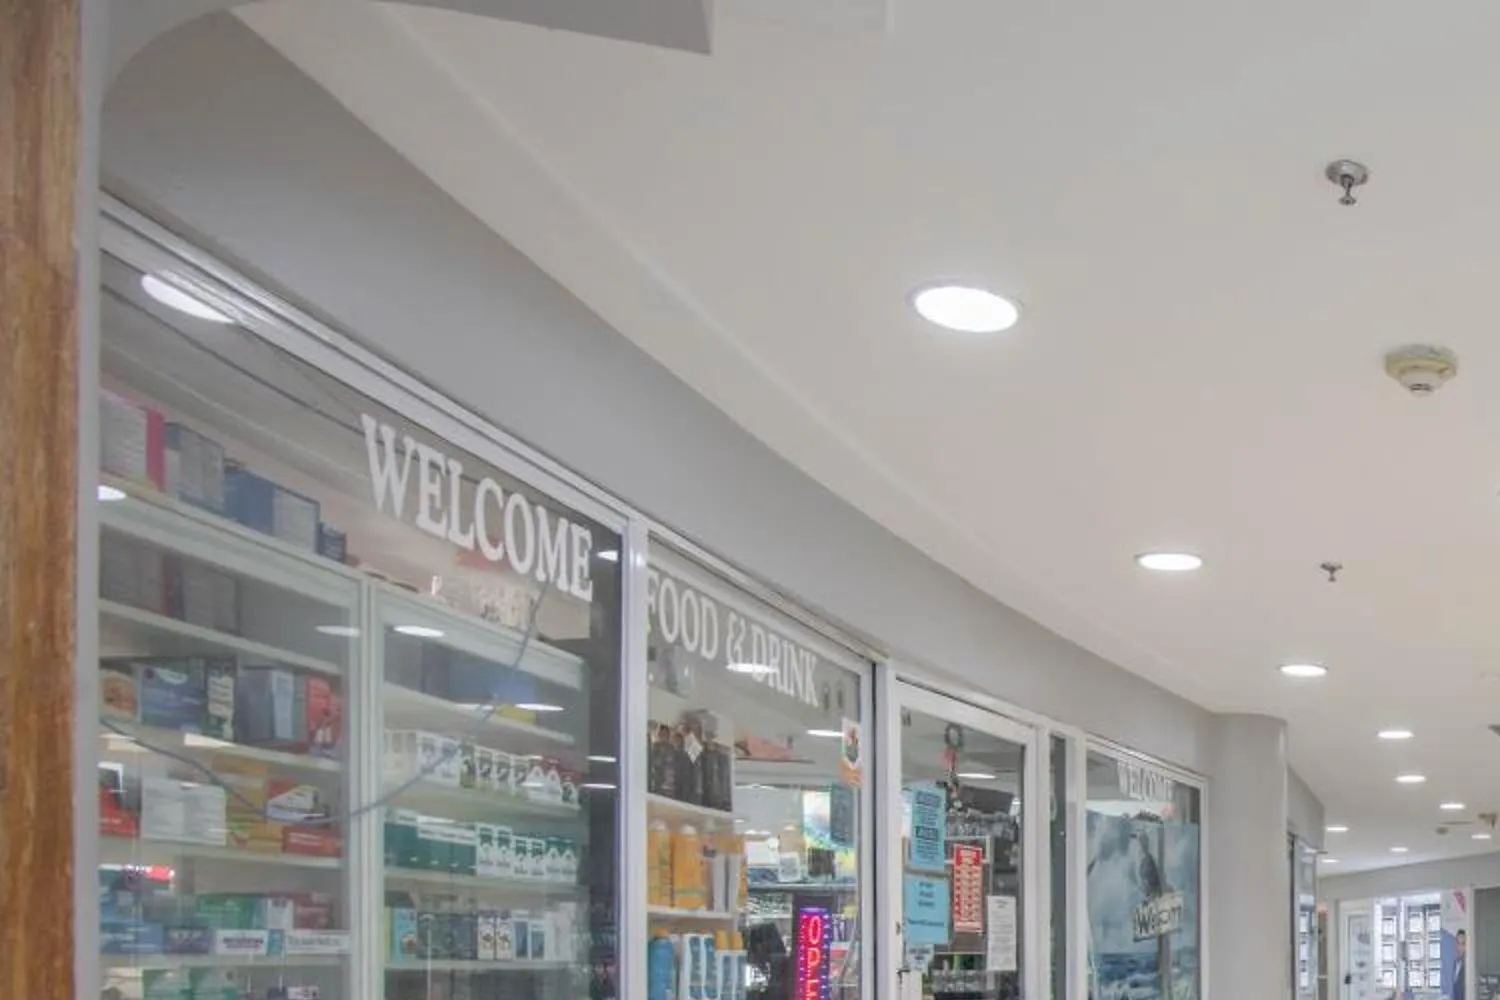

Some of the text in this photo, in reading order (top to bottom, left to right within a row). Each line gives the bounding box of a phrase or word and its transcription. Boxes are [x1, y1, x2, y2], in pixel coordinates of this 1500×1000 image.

[361, 413, 593, 602] WELCOME
[647, 569, 719, 661] FOOD
[751, 624, 819, 708] DRINK
